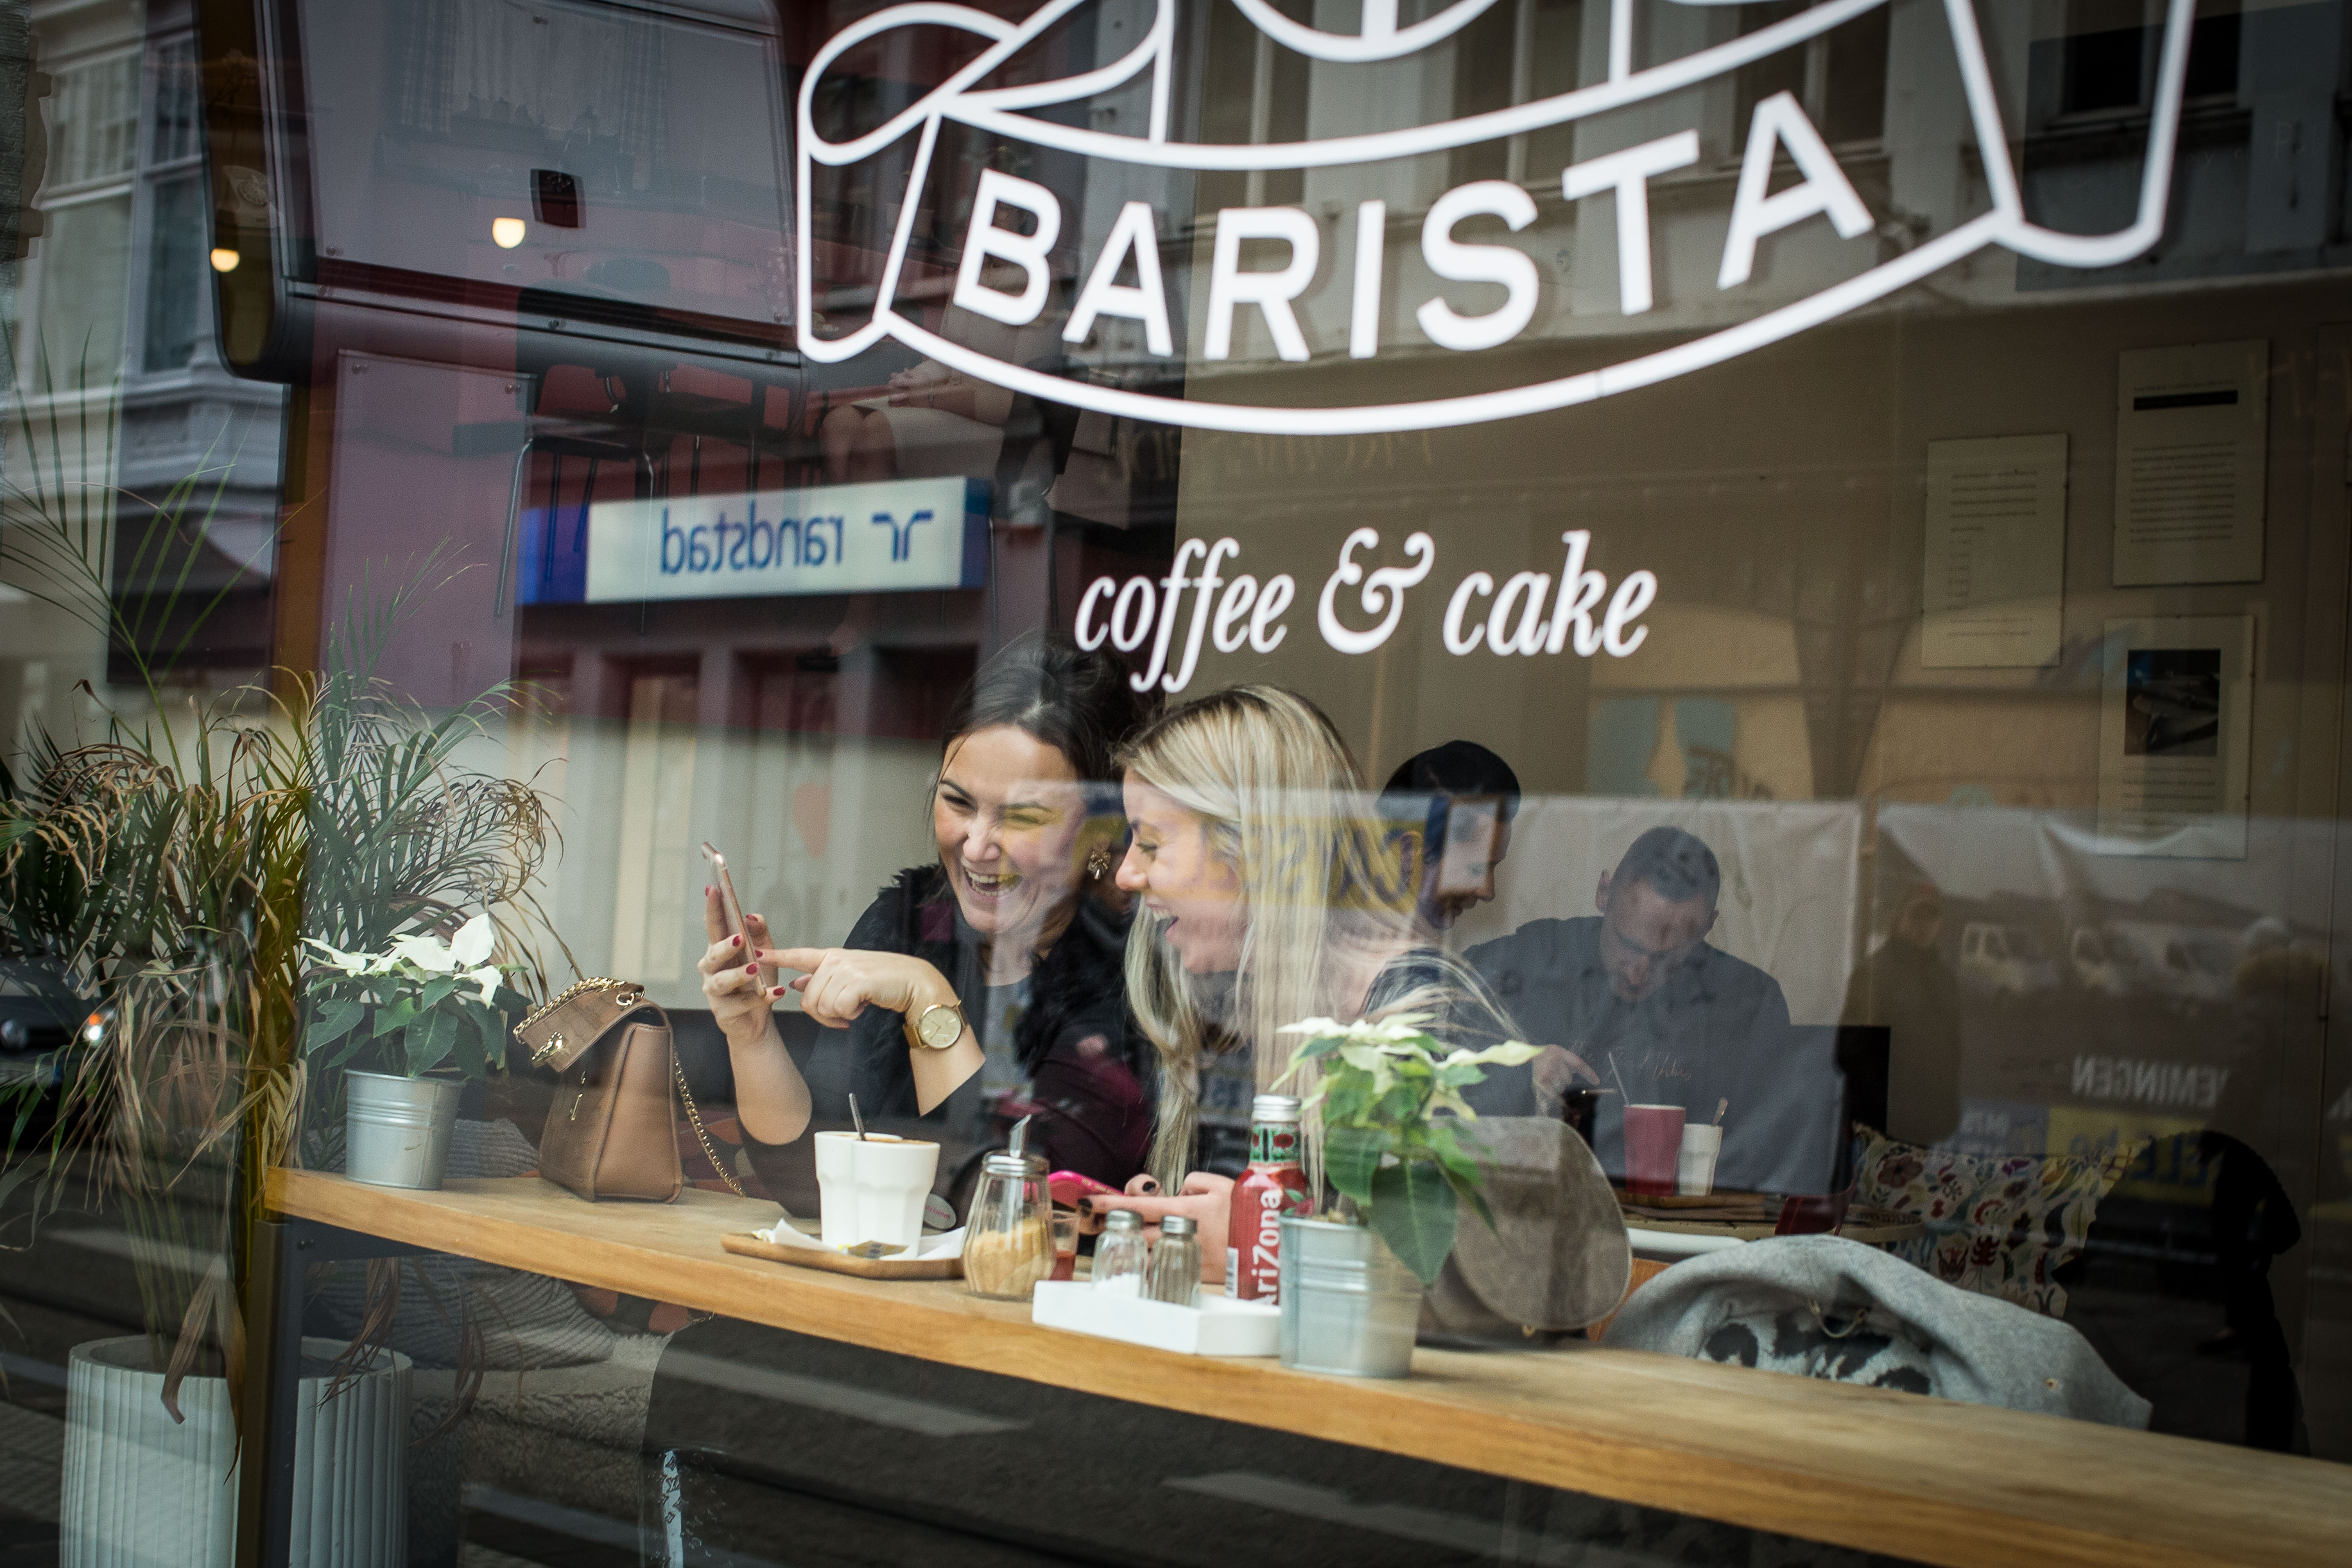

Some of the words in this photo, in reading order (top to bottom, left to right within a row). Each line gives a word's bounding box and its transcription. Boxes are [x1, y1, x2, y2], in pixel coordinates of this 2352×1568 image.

[952, 92, 1874, 364] BARISTA
[1074, 537, 1296, 694] coffee
[1317, 527, 1435, 655] &
[1442, 529, 1657, 658] cake
